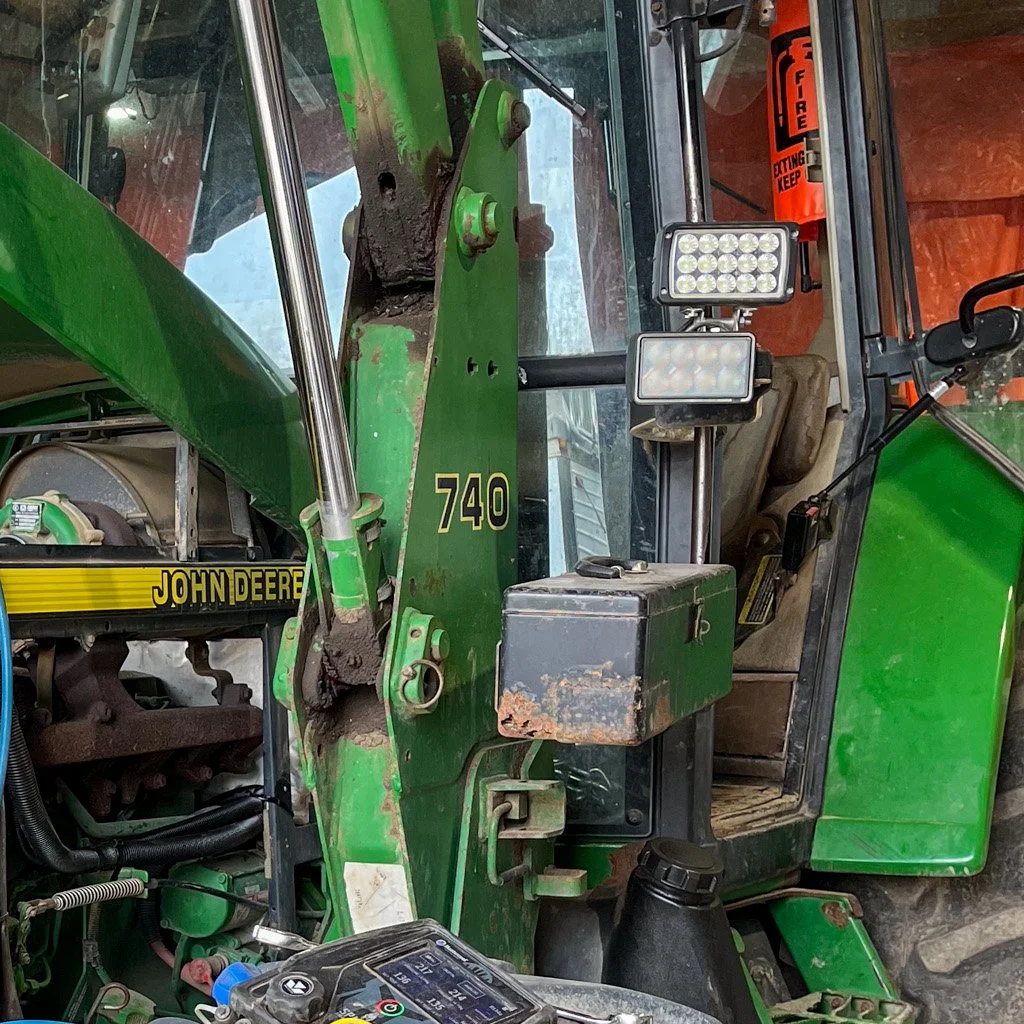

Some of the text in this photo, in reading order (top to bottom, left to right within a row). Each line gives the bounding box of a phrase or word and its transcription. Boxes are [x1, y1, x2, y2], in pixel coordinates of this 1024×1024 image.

[795, 69, 807, 130] FIRE
[778, 169, 801, 193] KEEP
[435, 472, 509, 533] 740
[152, 570, 304, 606] JOHN DEERE
[392, 971, 411, 985] 136
[414, 963, 433, 976] 217
[448, 988, 467, 1001] 214
[427, 998, 445, 1012] 135
